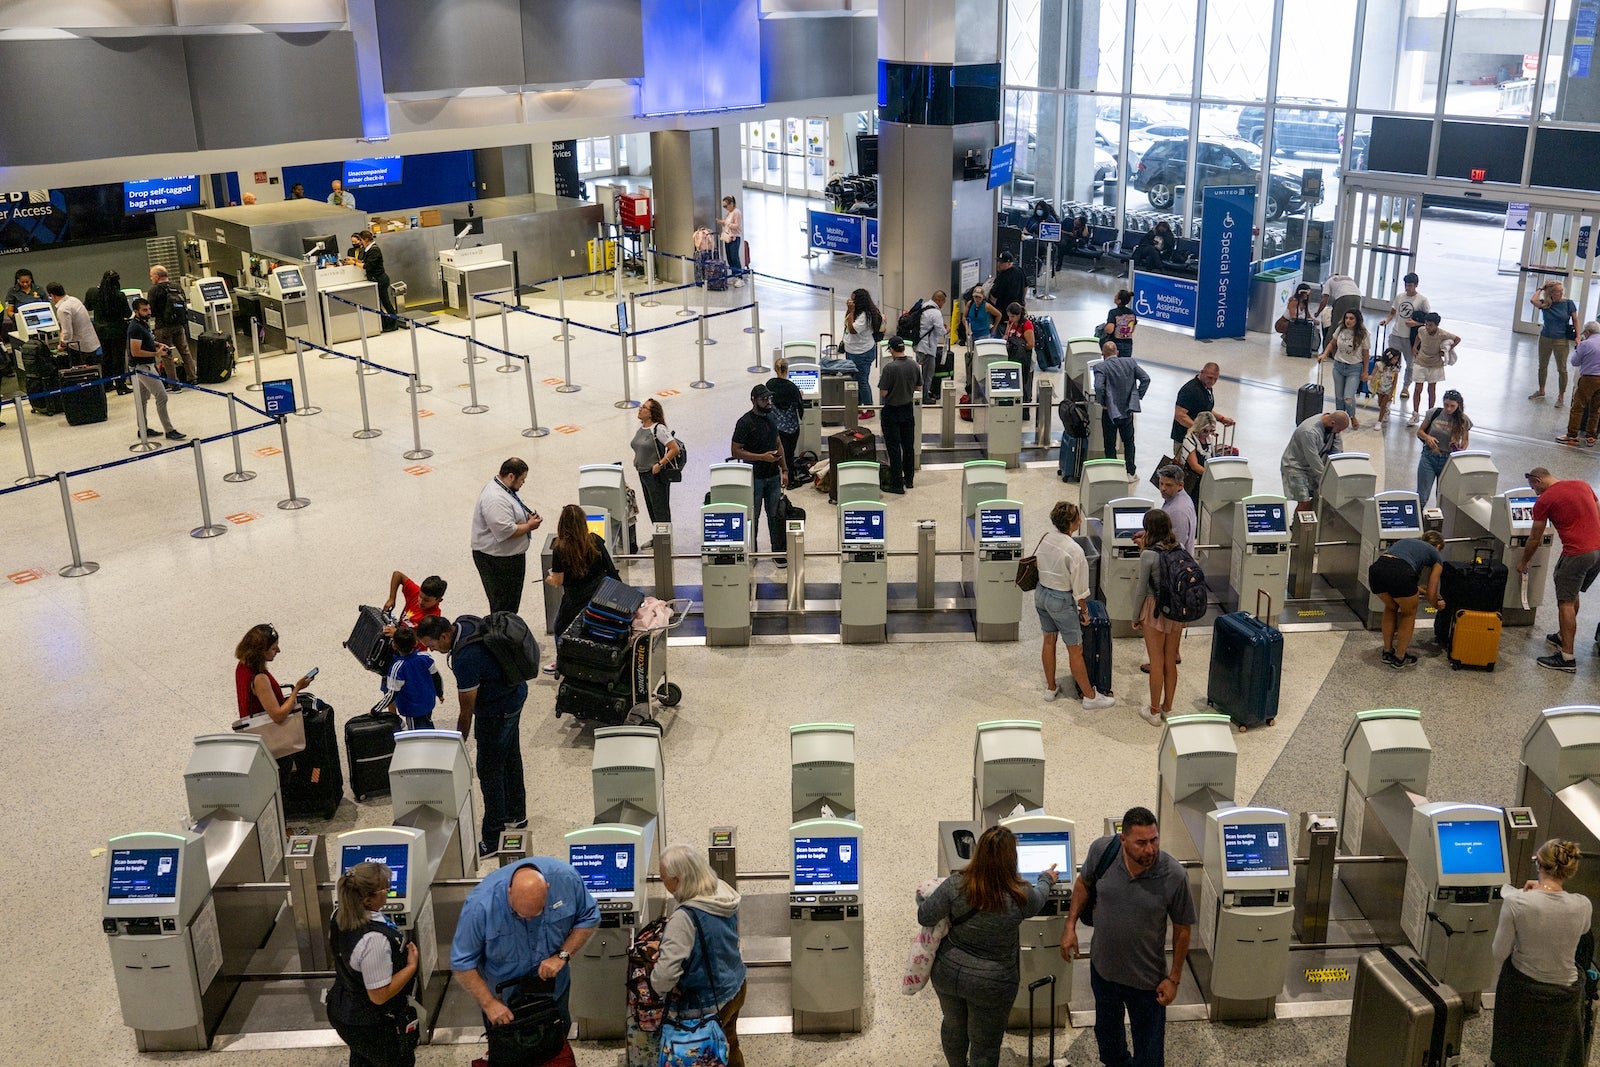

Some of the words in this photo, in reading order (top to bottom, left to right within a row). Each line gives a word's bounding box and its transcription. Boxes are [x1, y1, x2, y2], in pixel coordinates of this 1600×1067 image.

[348, 168, 388, 176] Unaccompanied
[1471, 169, 1486, 180] EXIT
[129, 190, 149, 200] Drop
[150, 185, 192, 196] self-tagged
[129, 199, 148, 209] bags
[149, 197, 167, 206] here
[13, 206, 52, 218] Access
[826, 227, 844, 236] Mobility
[826, 234, 849, 244] Assistance
[1219, 231, 1233, 275] Special
[1156, 294, 1183, 306] Mobility
[1216, 278, 1229, 328] Services
[1155, 311, 1170, 319] area
[1156, 304, 1189, 315] Assistance
[127, 858, 148, 866] boarding
[364, 856, 387, 864] Closed
